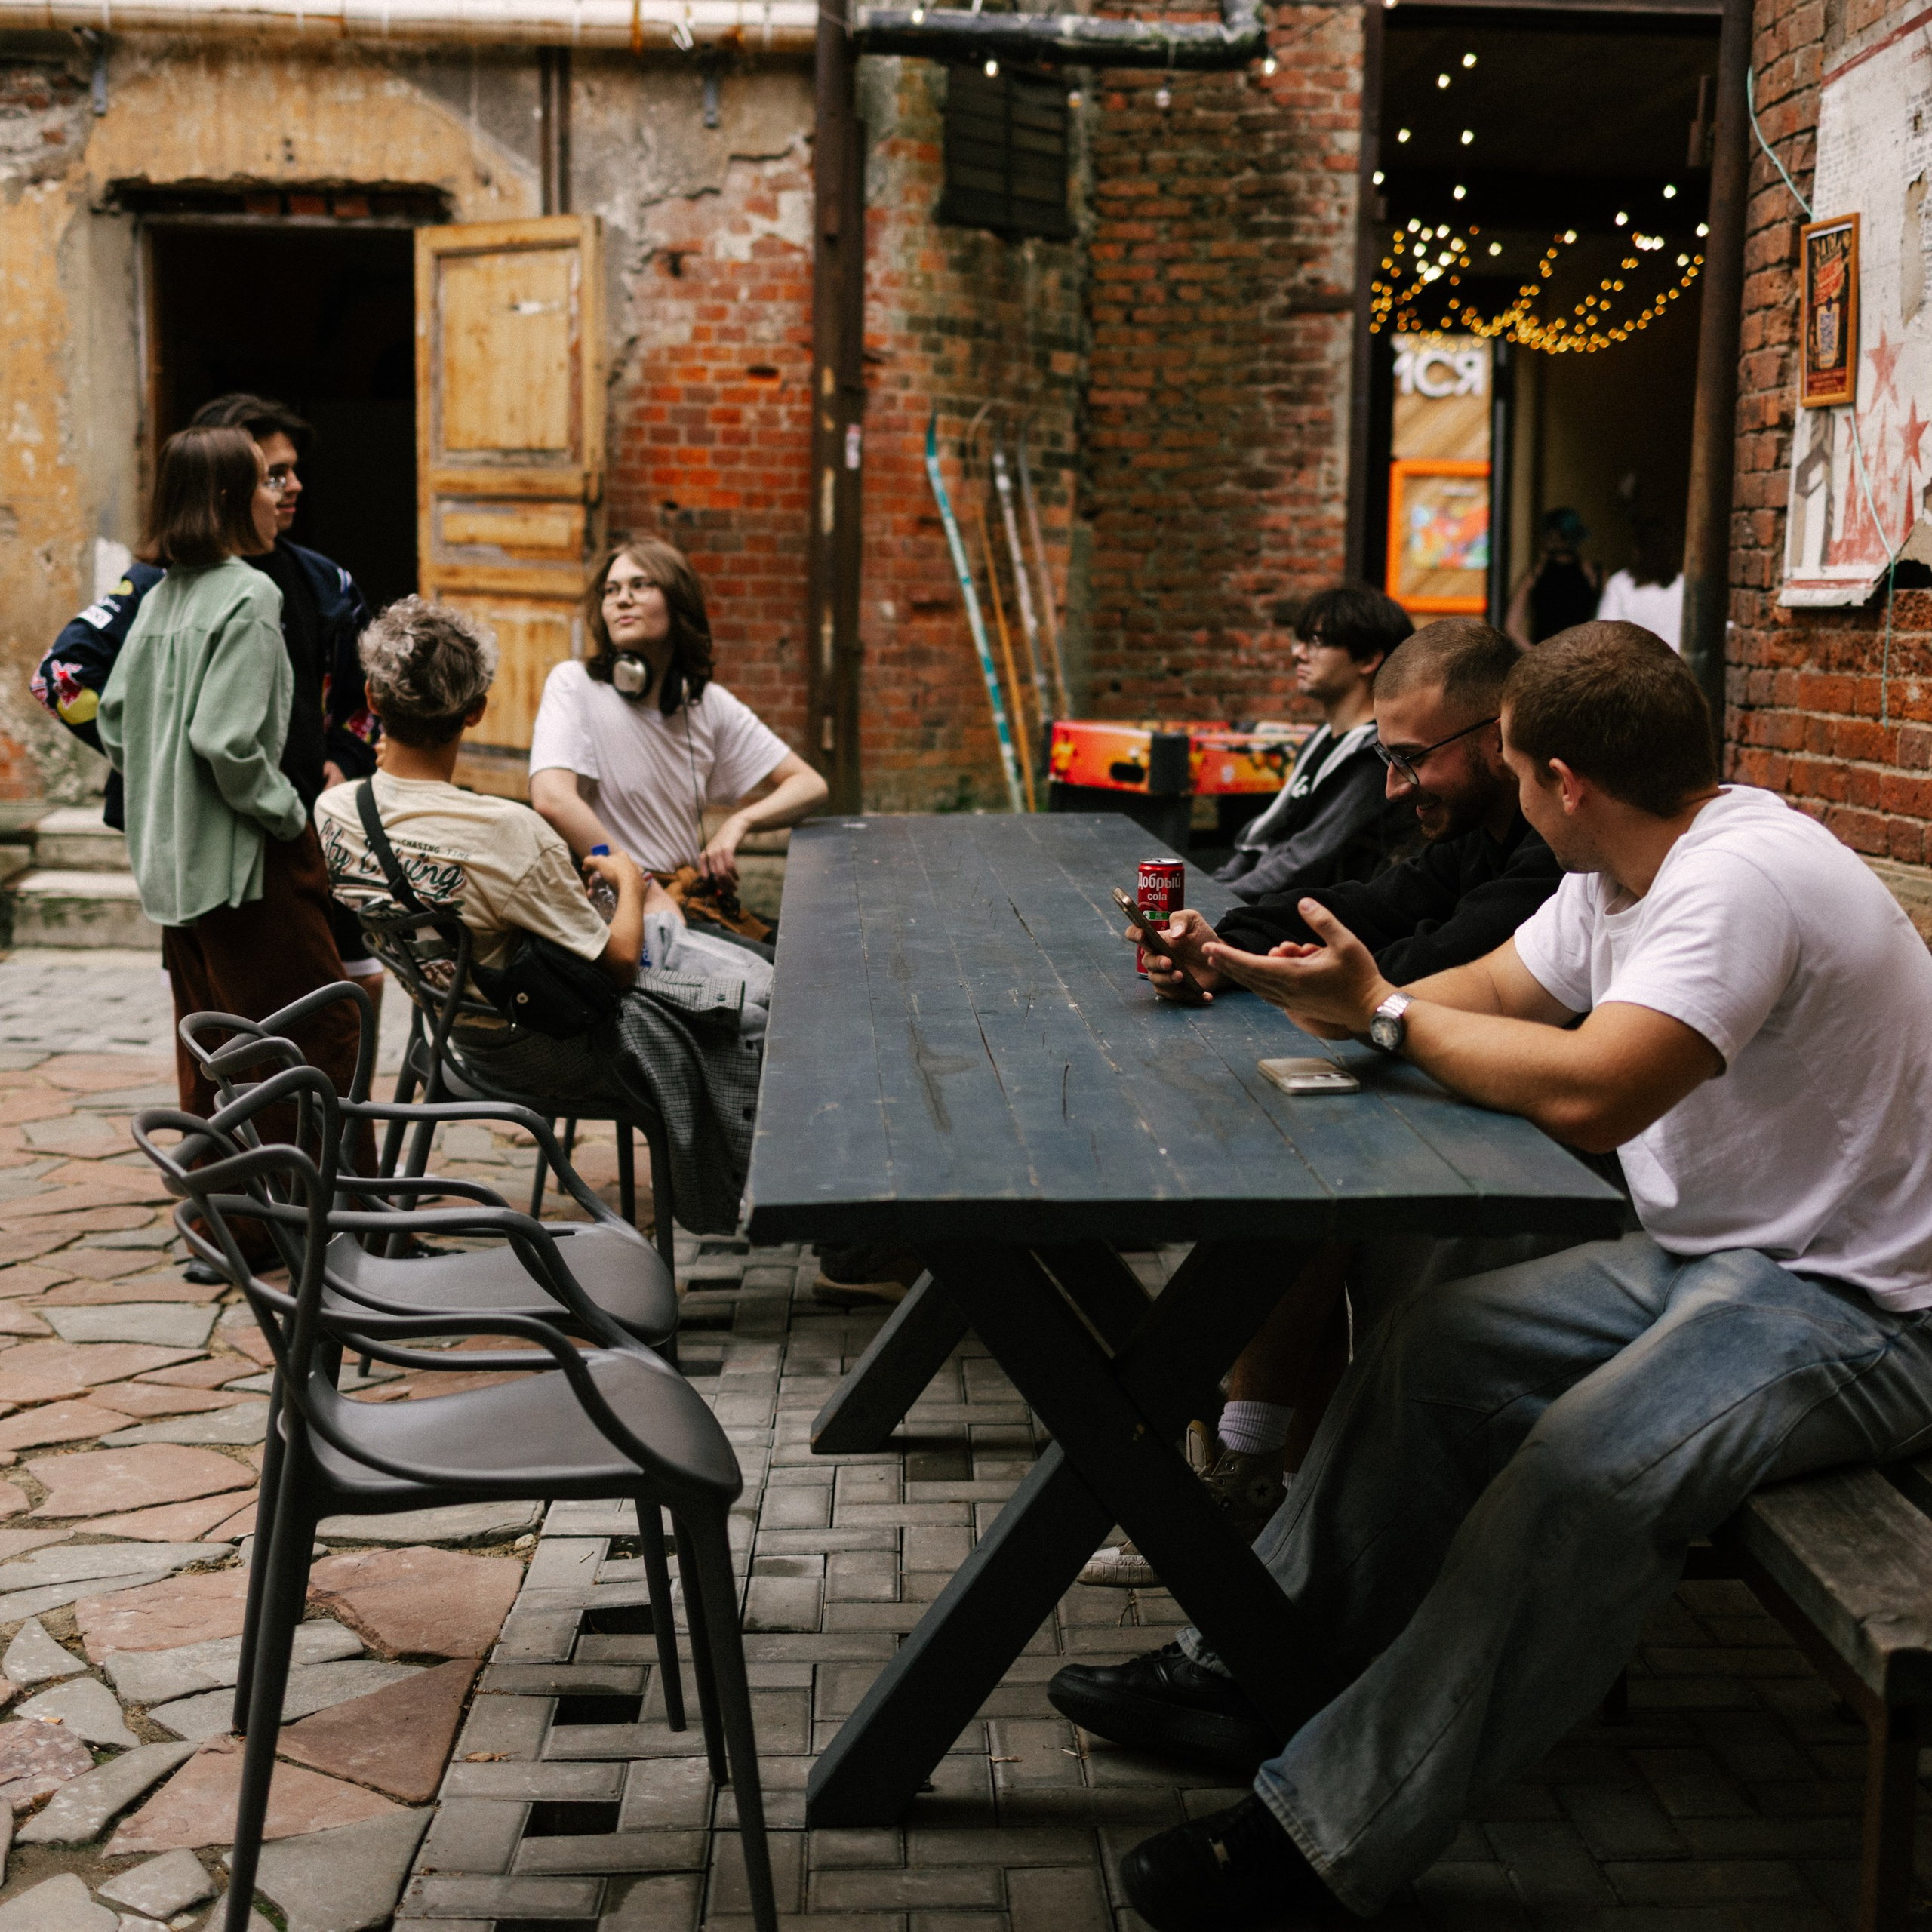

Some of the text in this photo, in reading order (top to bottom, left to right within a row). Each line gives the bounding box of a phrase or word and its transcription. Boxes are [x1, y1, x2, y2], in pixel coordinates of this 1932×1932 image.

[401, 838, 441, 854] CHASING
[1138, 872, 1181, 891] Добрый
[1147, 892, 1168, 901] cola
